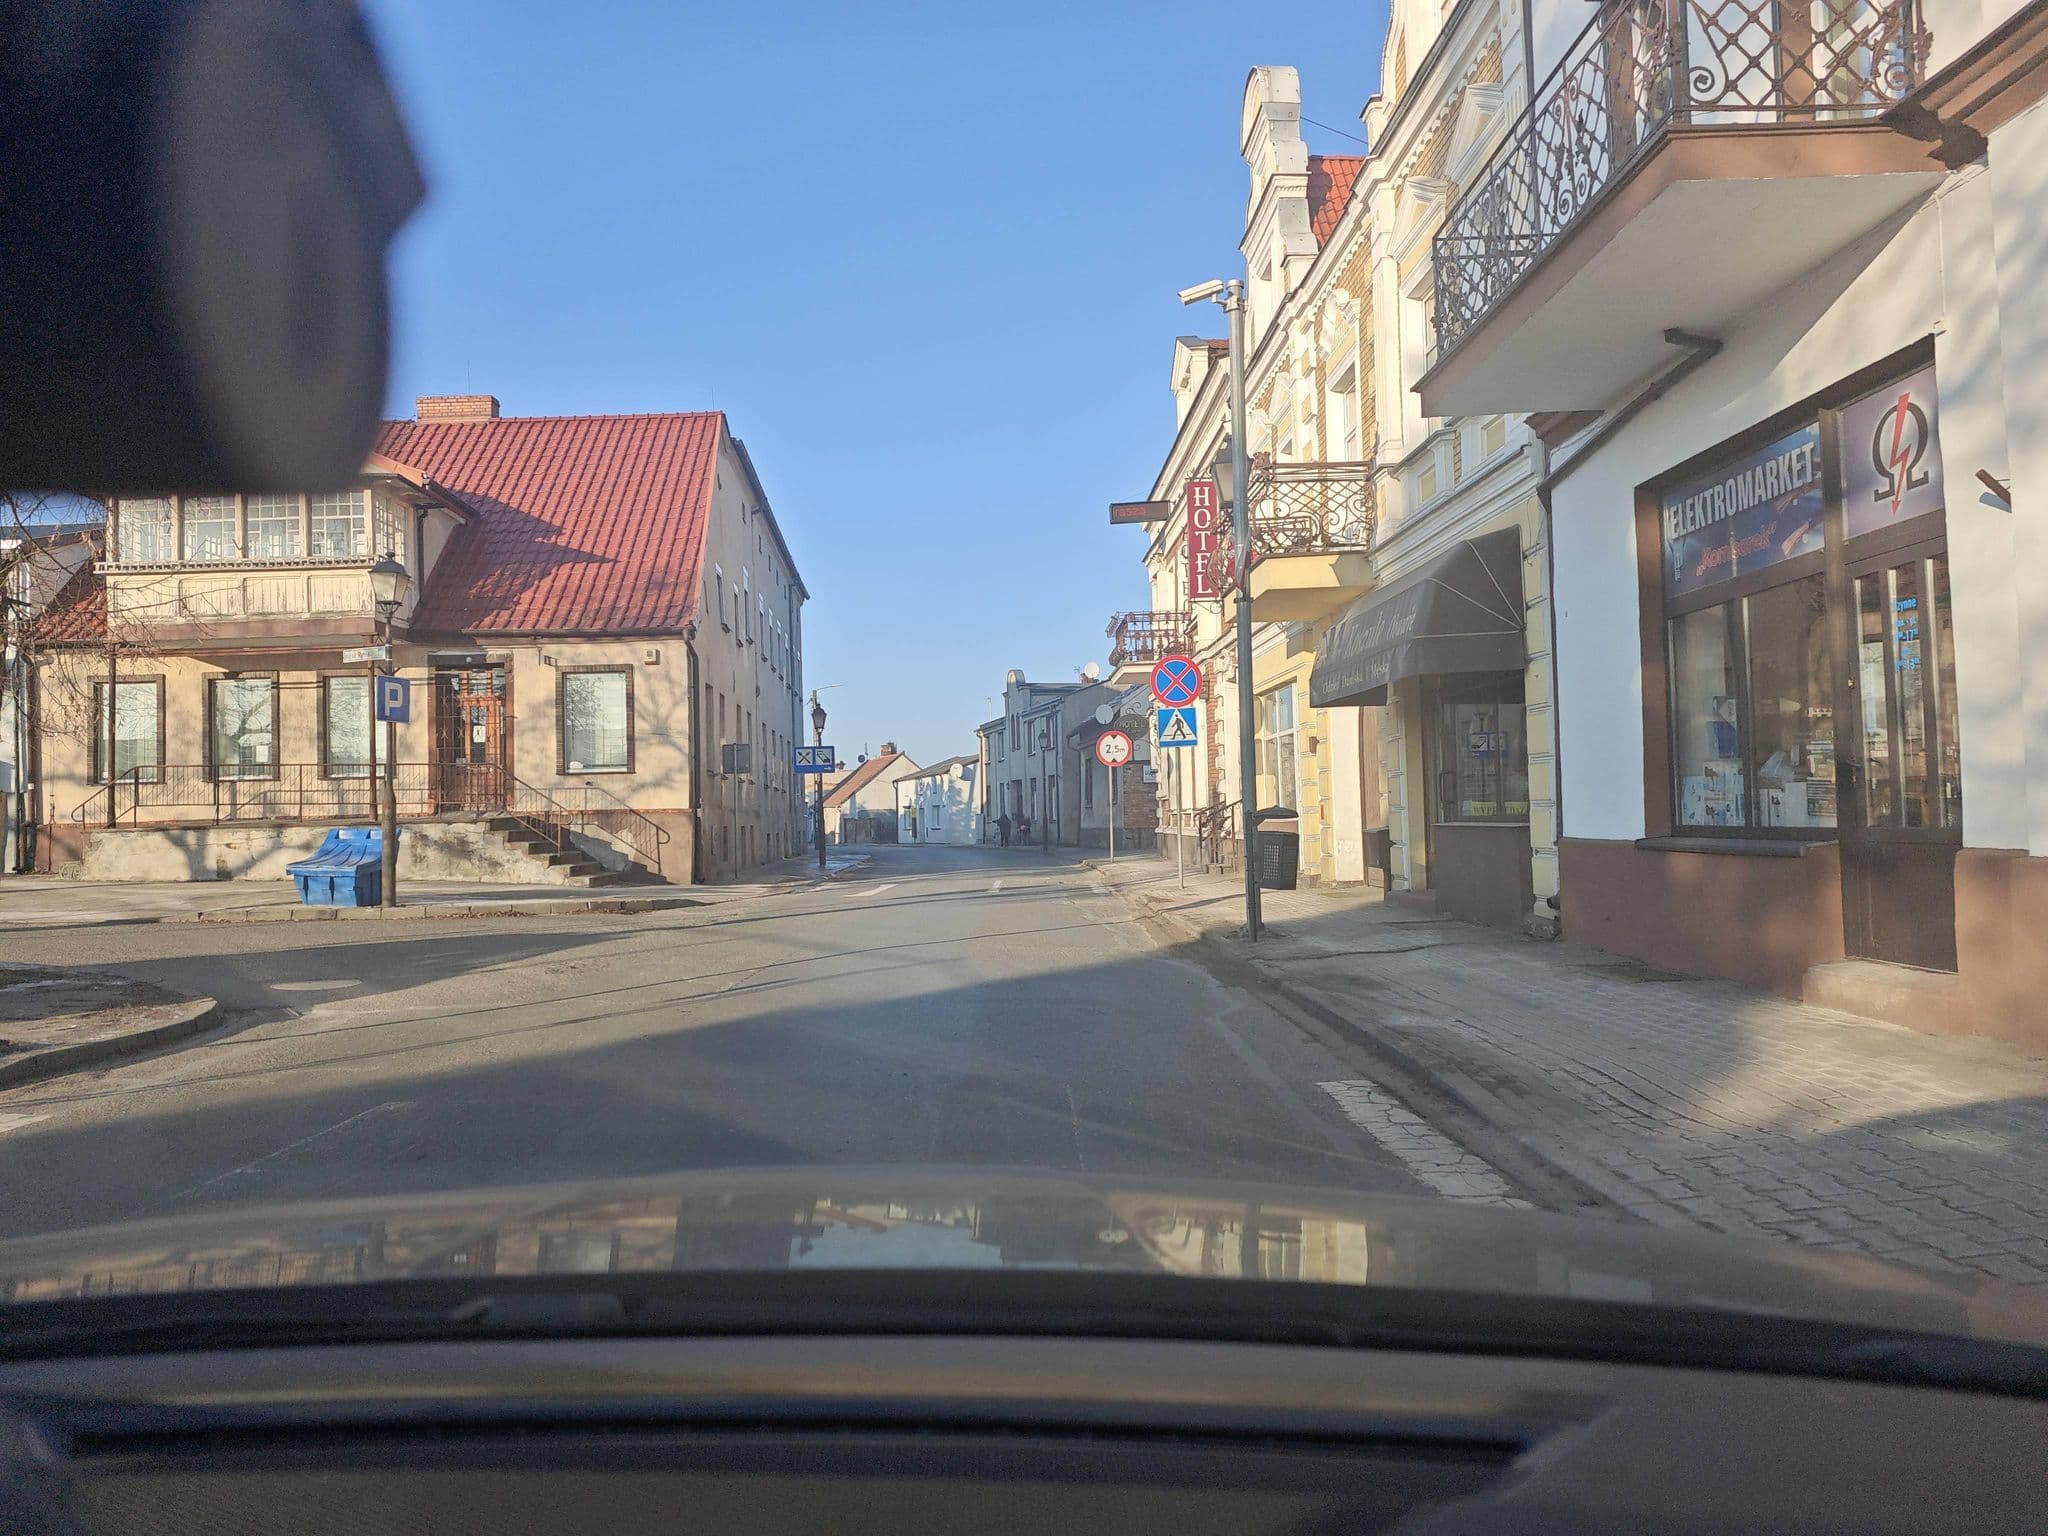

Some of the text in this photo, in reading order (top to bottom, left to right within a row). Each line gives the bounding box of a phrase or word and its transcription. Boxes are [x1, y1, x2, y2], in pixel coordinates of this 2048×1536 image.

[1194, 486, 1213, 594] HOTEL
[1669, 441, 1815, 540] ELEKTROMARKET
[384, 681, 403, 717] P
